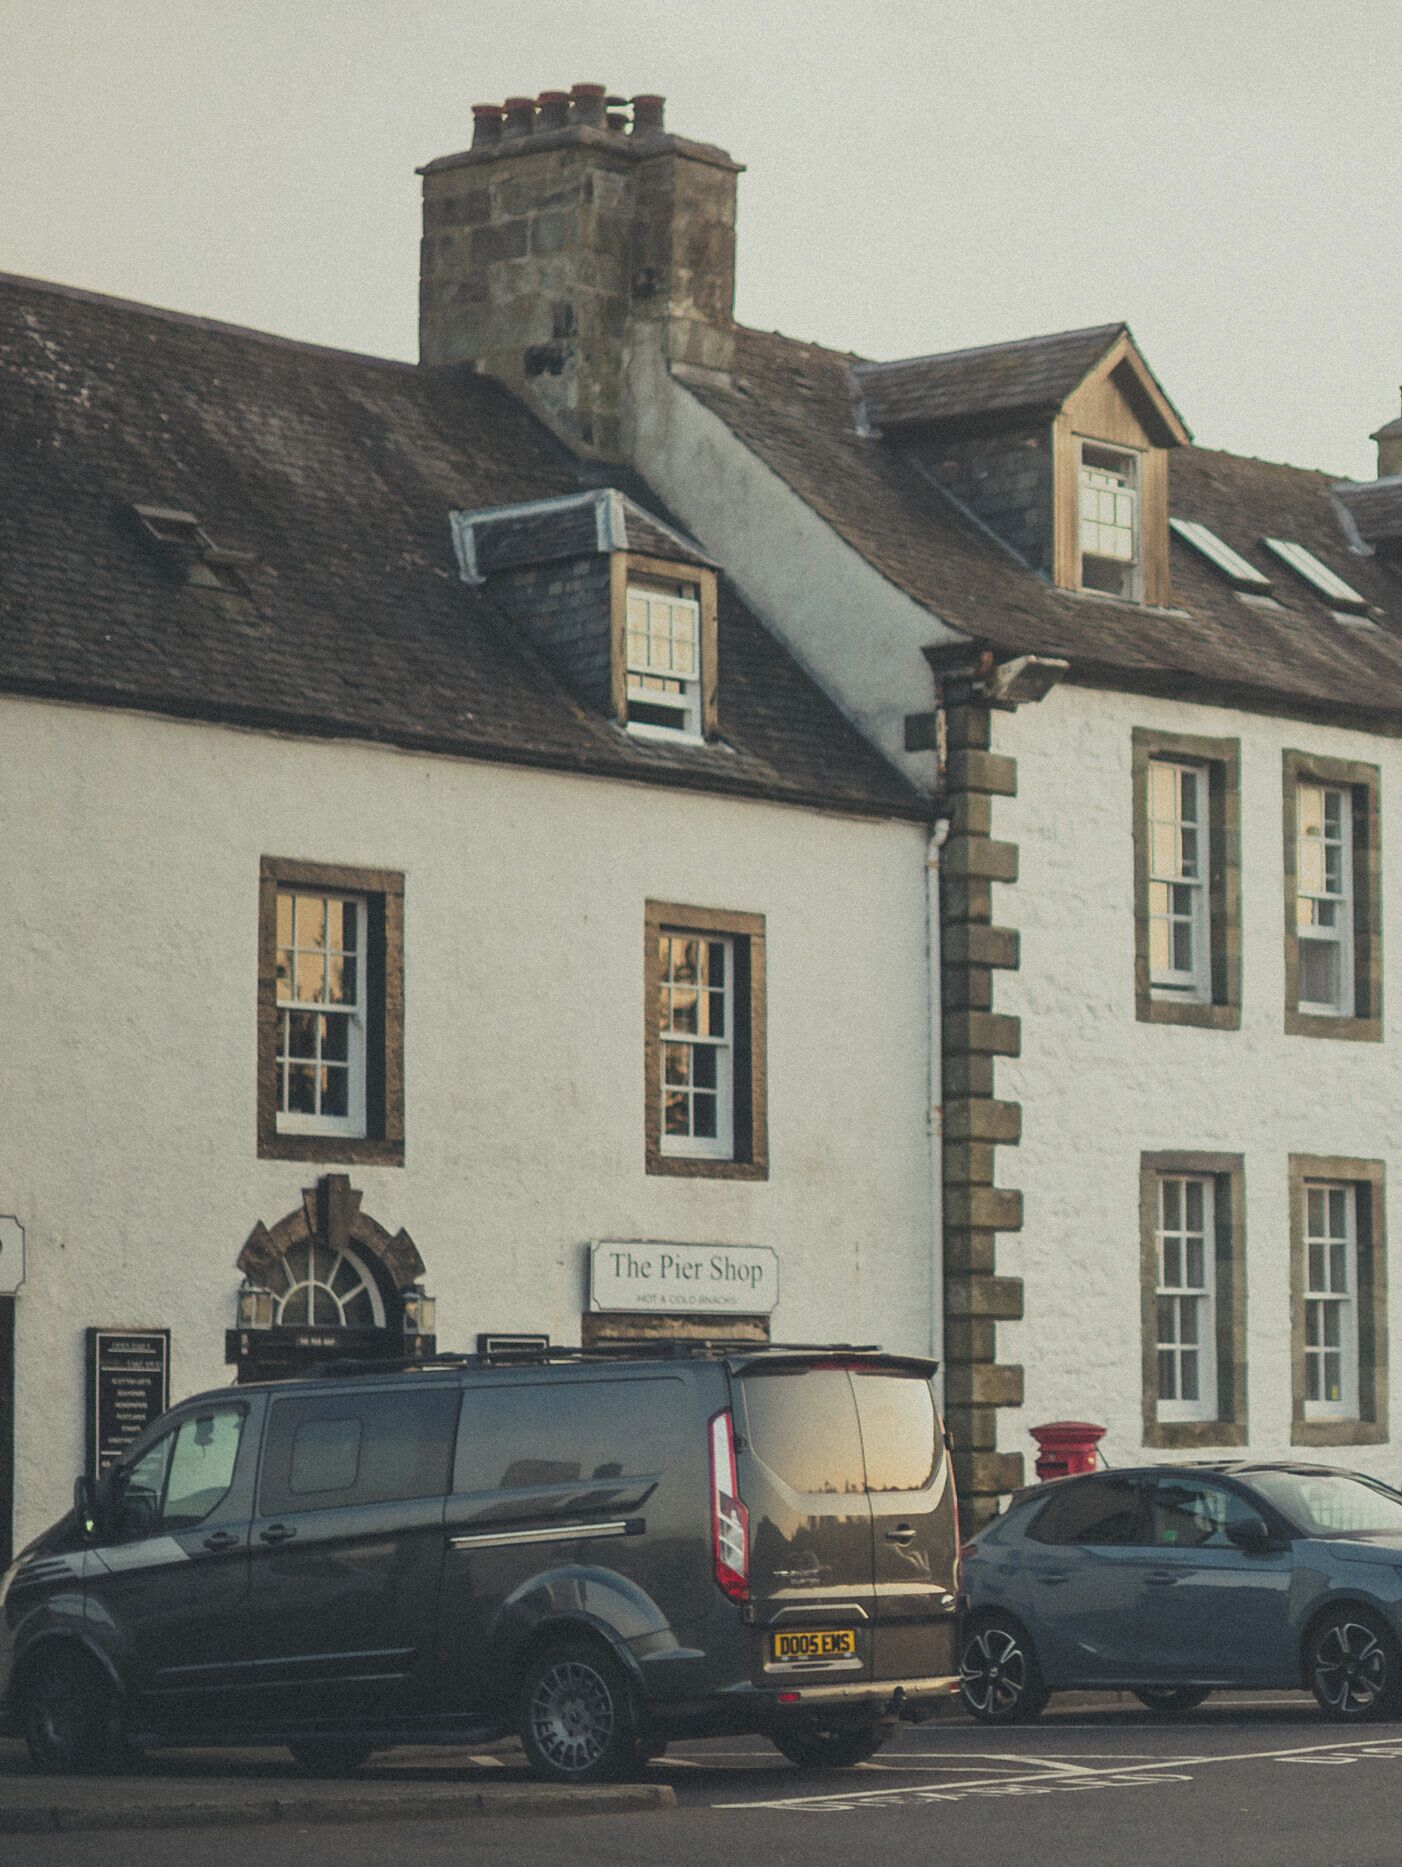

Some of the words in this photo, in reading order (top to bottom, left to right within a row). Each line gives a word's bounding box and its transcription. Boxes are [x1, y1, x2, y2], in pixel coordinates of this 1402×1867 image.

[610, 1253, 651, 1279] The
[660, 1254, 702, 1280] Pier
[711, 1255, 763, 1288] Shop
